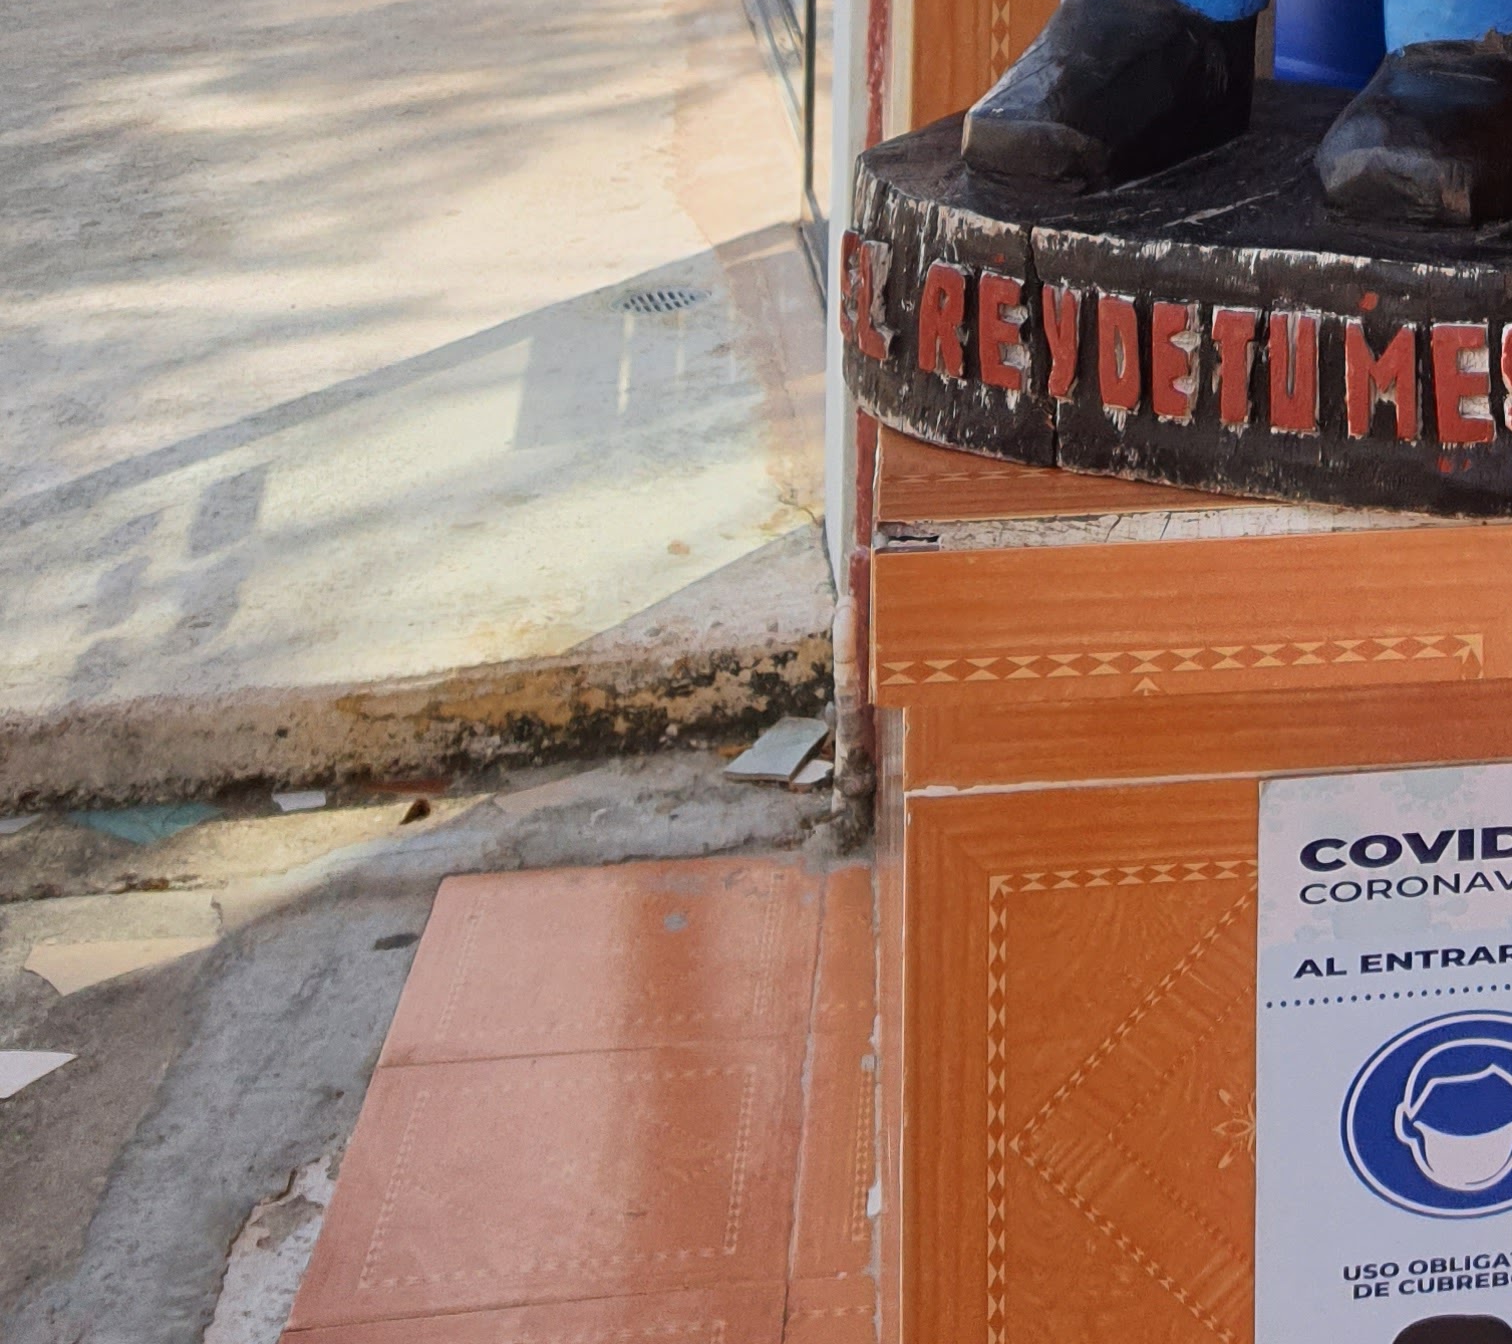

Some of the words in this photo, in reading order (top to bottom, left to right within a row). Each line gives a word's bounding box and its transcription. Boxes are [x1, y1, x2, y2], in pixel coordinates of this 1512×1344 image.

[917, 262, 1081, 399] REY
[1097, 293, 1190, 418] DE
[1211, 308, 1319, 432] TU
[1293, 956, 1348, 979] AL
[1342, 1261, 1400, 1282] USO
[1352, 1280, 1390, 1300] DE
